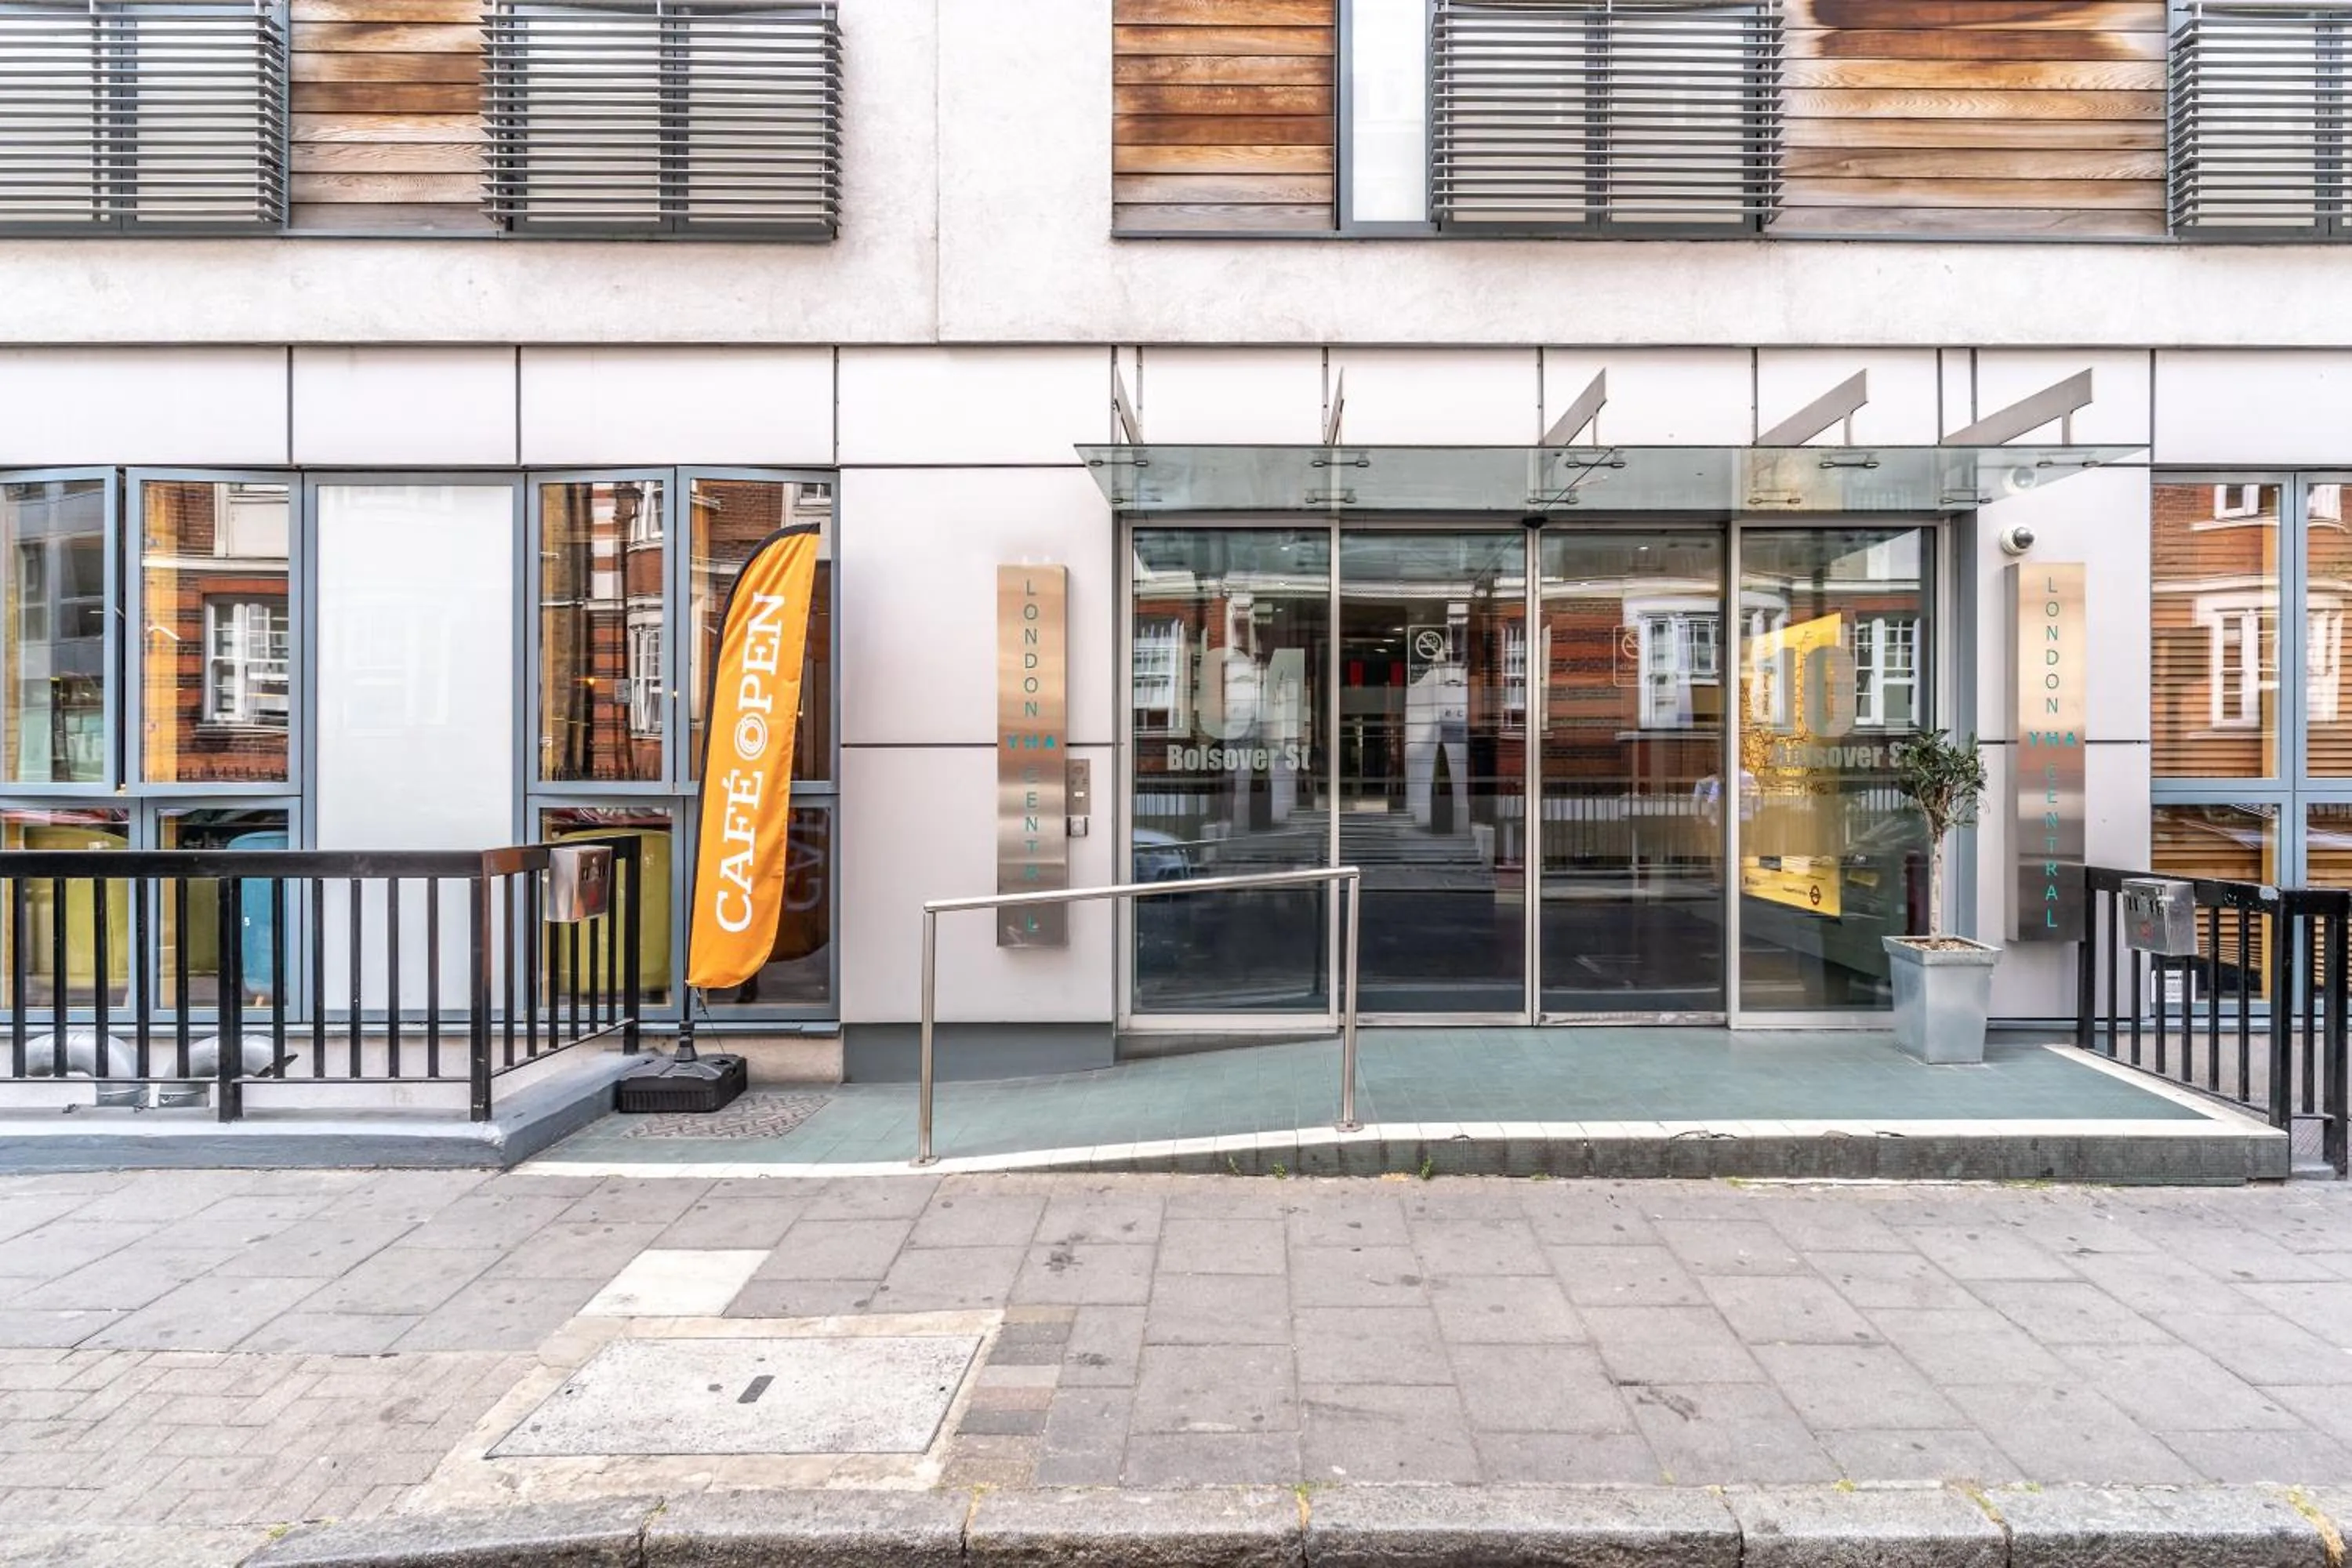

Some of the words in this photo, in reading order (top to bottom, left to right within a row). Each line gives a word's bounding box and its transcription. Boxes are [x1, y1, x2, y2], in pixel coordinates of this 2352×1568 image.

[734, 591, 786, 761] OPEN
[1023, 579, 1039, 717] LONDON
[2045, 577, 2060, 713] LONDON
[1007, 735, 1056, 750] YHA
[1167, 744, 1279, 771] Bolsover
[1285, 743, 1311, 771] St
[1769, 743, 1883, 768] sover
[2028, 730, 2078, 746] YHA
[716, 768, 765, 933] CAFÉ
[1024, 766, 1040, 933] CENTRL
[2045, 762, 2059, 928] CENTRAL
